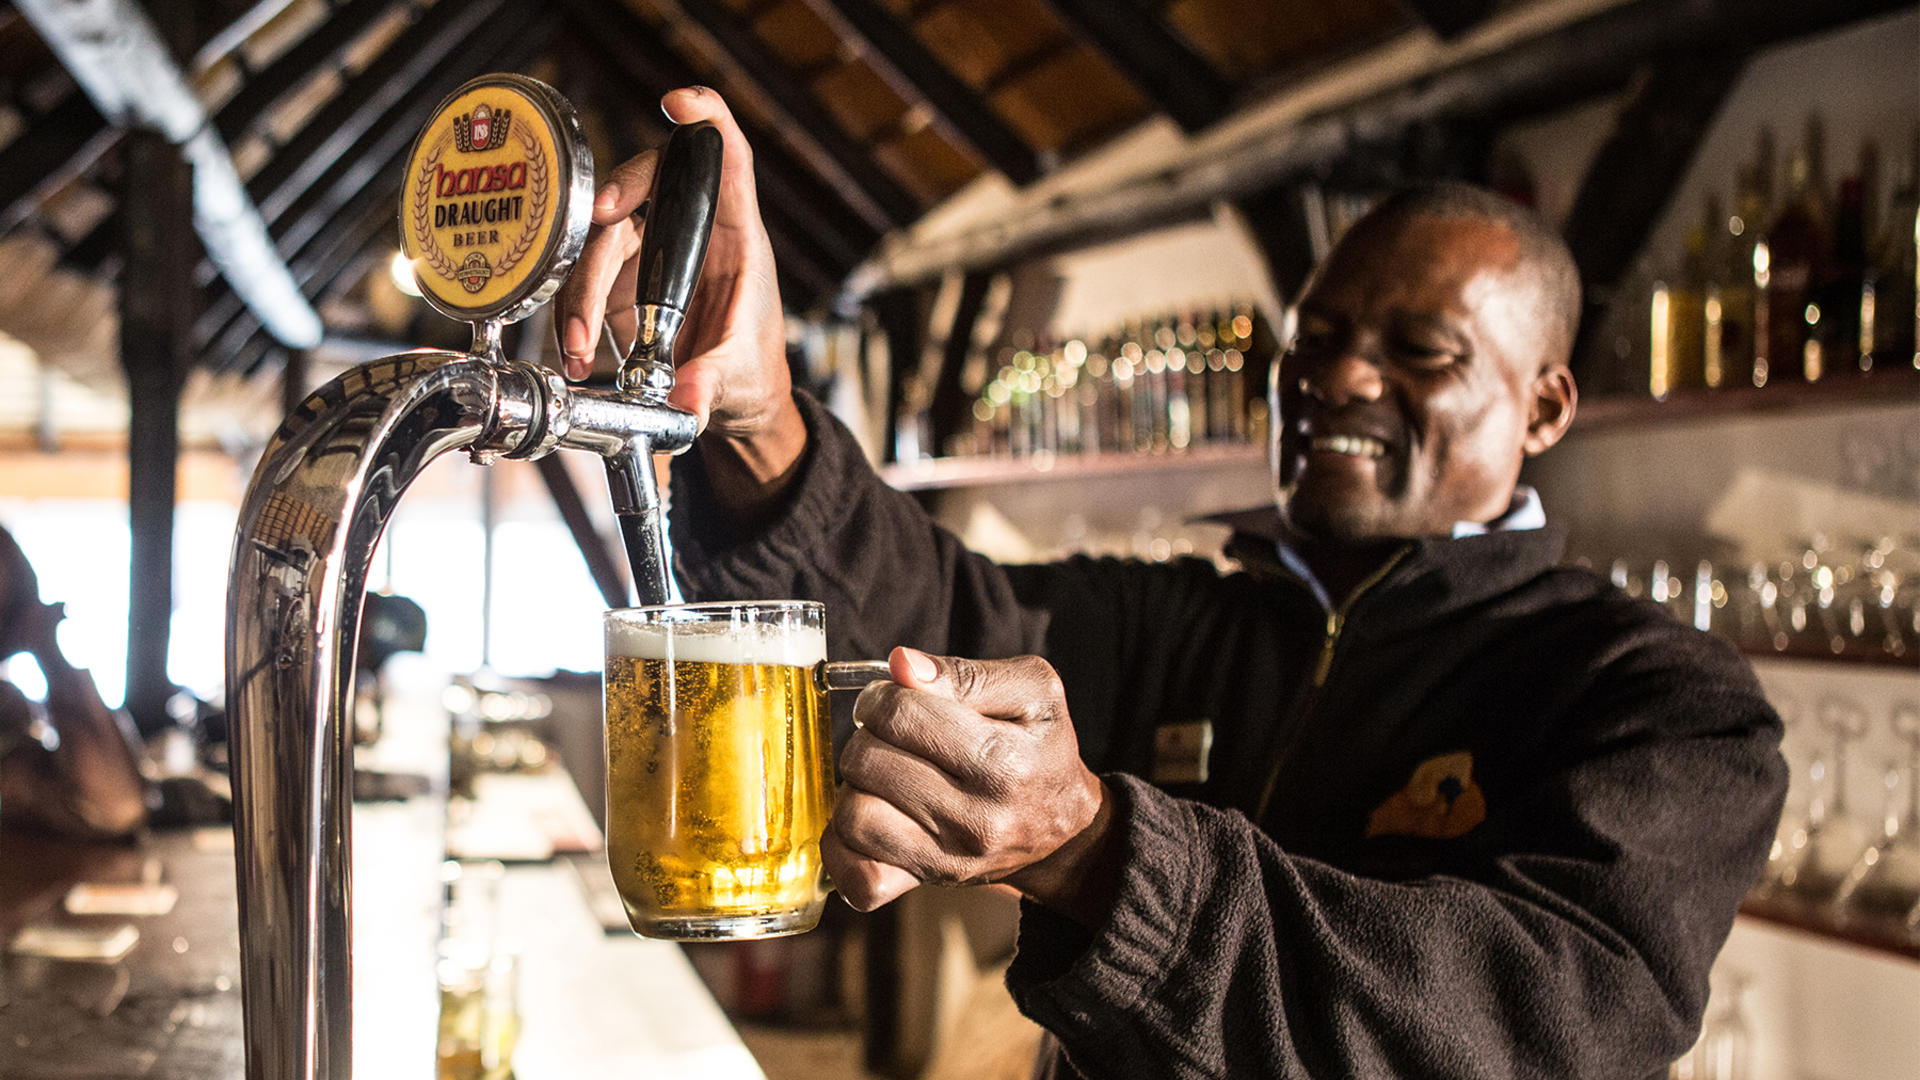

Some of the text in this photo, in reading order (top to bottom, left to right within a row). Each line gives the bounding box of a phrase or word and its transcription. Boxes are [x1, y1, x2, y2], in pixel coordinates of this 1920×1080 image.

[436, 162, 527, 197] hansa
[434, 196, 522, 228] DRAUGHT
[453, 230, 499, 247] BEER
